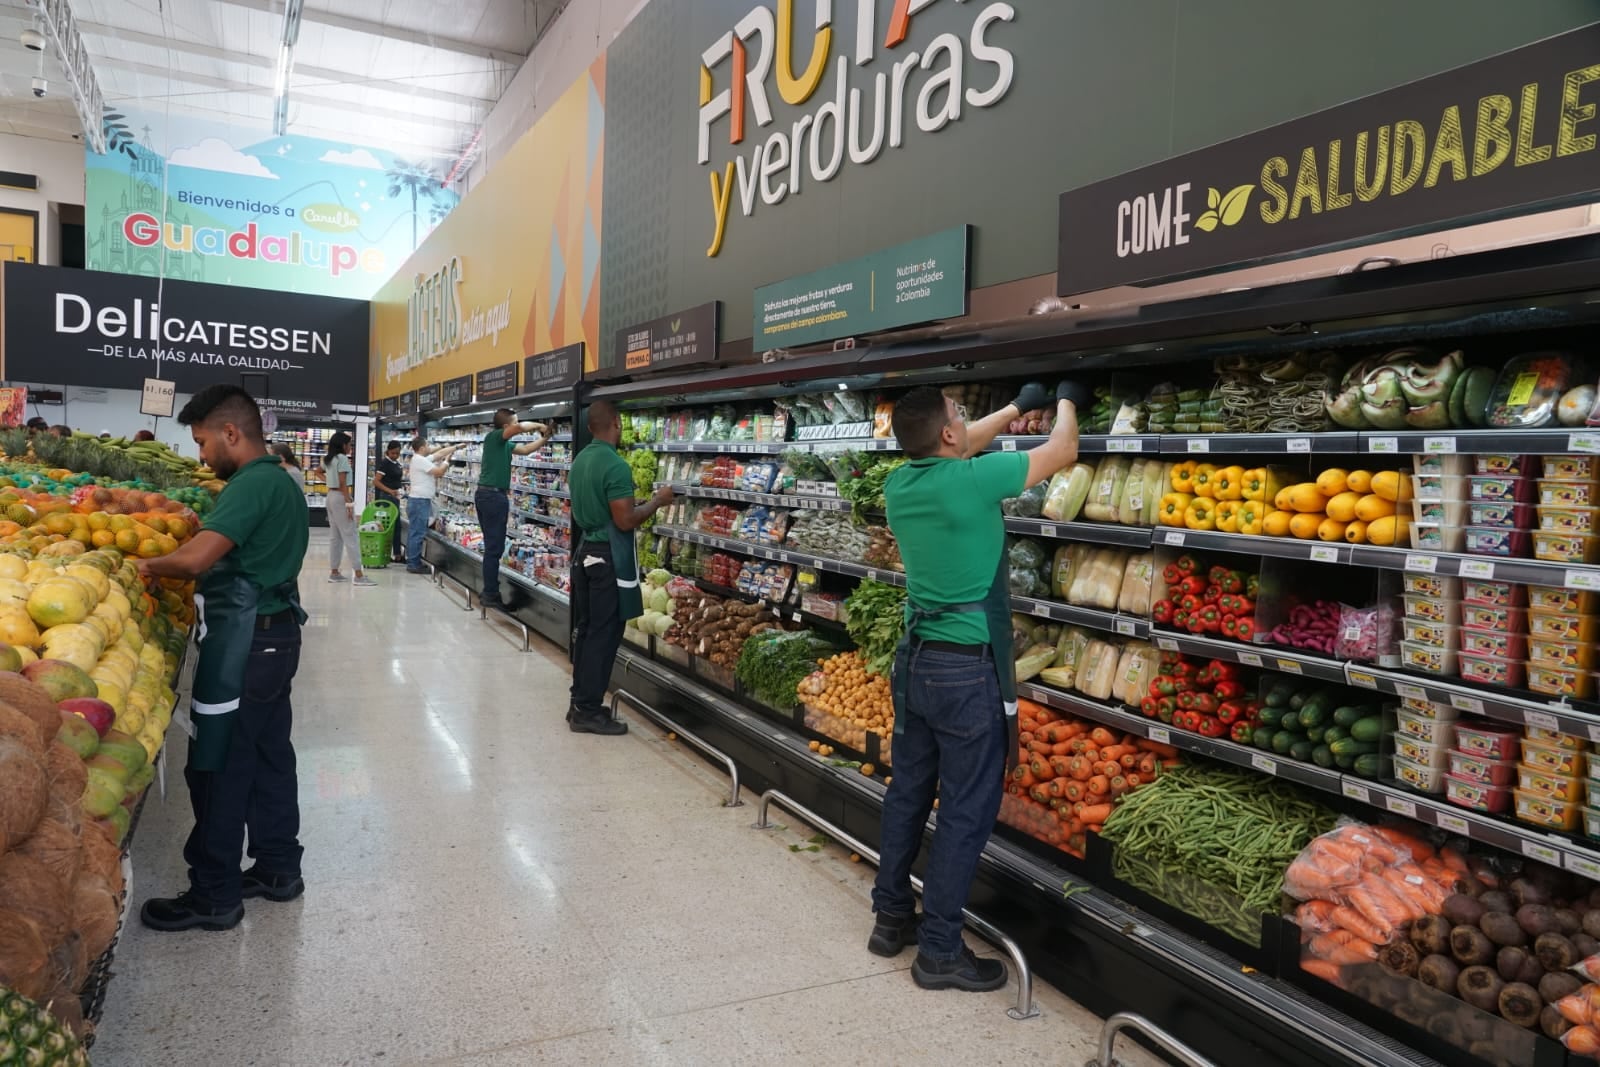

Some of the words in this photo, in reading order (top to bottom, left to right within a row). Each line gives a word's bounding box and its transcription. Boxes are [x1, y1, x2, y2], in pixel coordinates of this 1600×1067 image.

[707, 161, 735, 257] y
[736, 3, 1014, 216] verduras
[1116, 182, 1191, 258] COME
[1259, 64, 1600, 224] SALUDABLE
[178, 190, 280, 216] Bienvenidos
[285, 206, 295, 218] a
[123, 213, 386, 277] Guadalupe
[927, 258, 936, 270] de
[828, 282, 853, 295] verduras
[896, 271, 944, 291] oportunidades
[901, 286, 930, 302] Colombia
[103, 344, 124, 359] DE
[128, 346, 147, 360] LA
[151, 347, 186, 363] MÁS
[190, 352, 224, 366] ALTA
[228, 355, 291, 371] CALIDAD
[278, 399, 317, 409] FRESCURA
